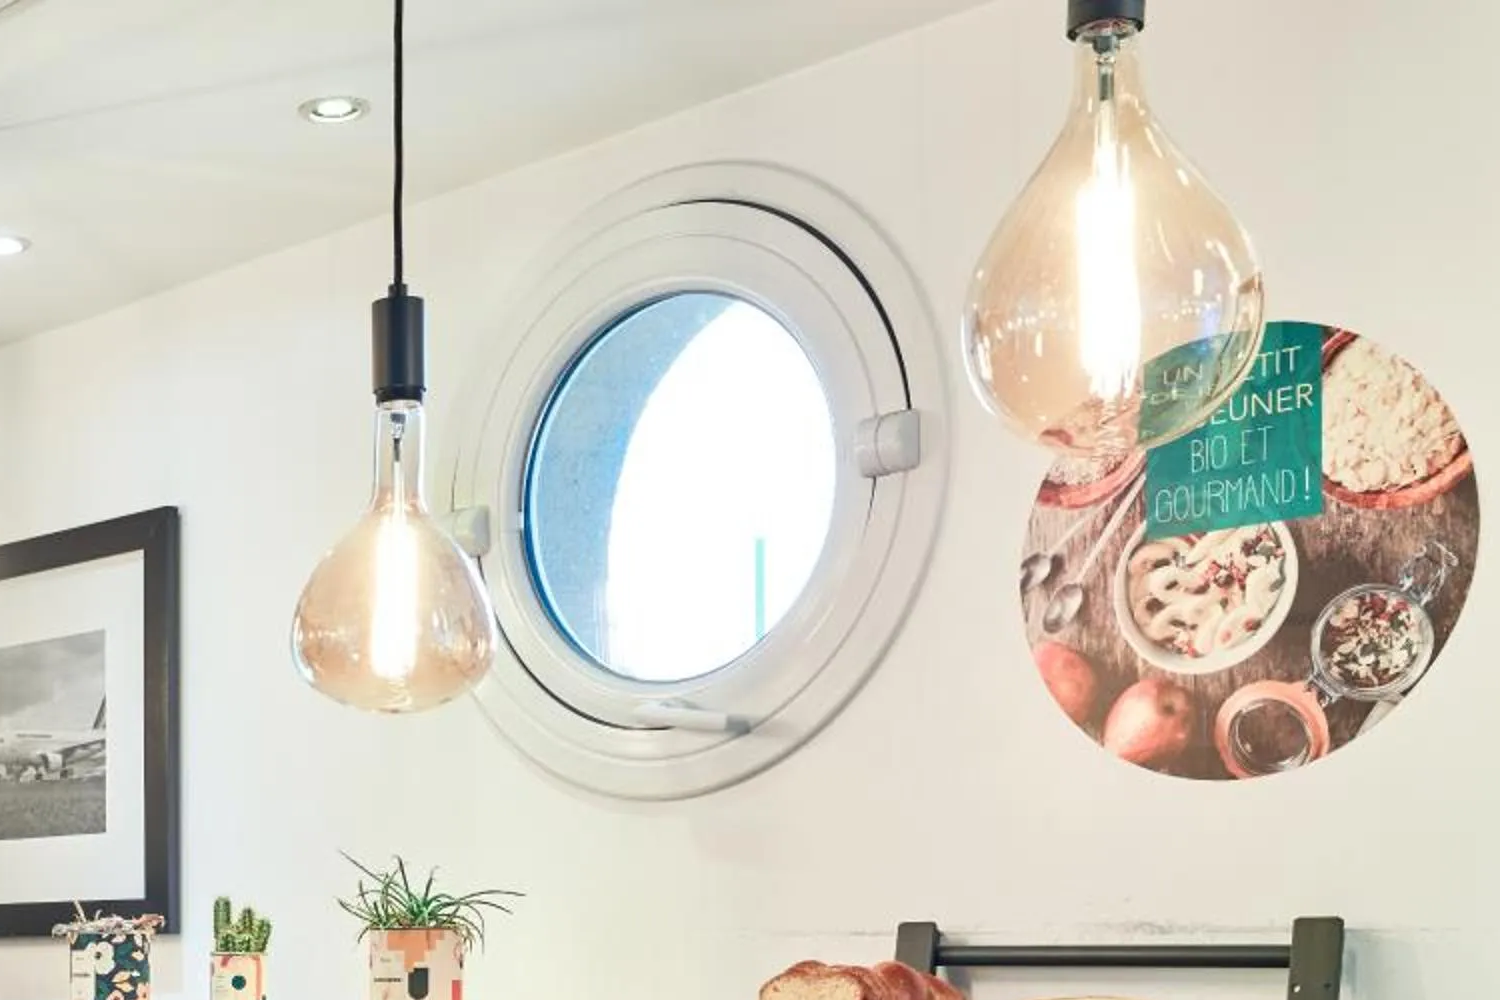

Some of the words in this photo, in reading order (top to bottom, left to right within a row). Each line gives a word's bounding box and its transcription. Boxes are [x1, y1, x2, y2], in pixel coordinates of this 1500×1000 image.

[1241, 345, 1303, 382] TIT
[1190, 435, 1228, 474] BIO
[1240, 425, 1274, 465] ET
